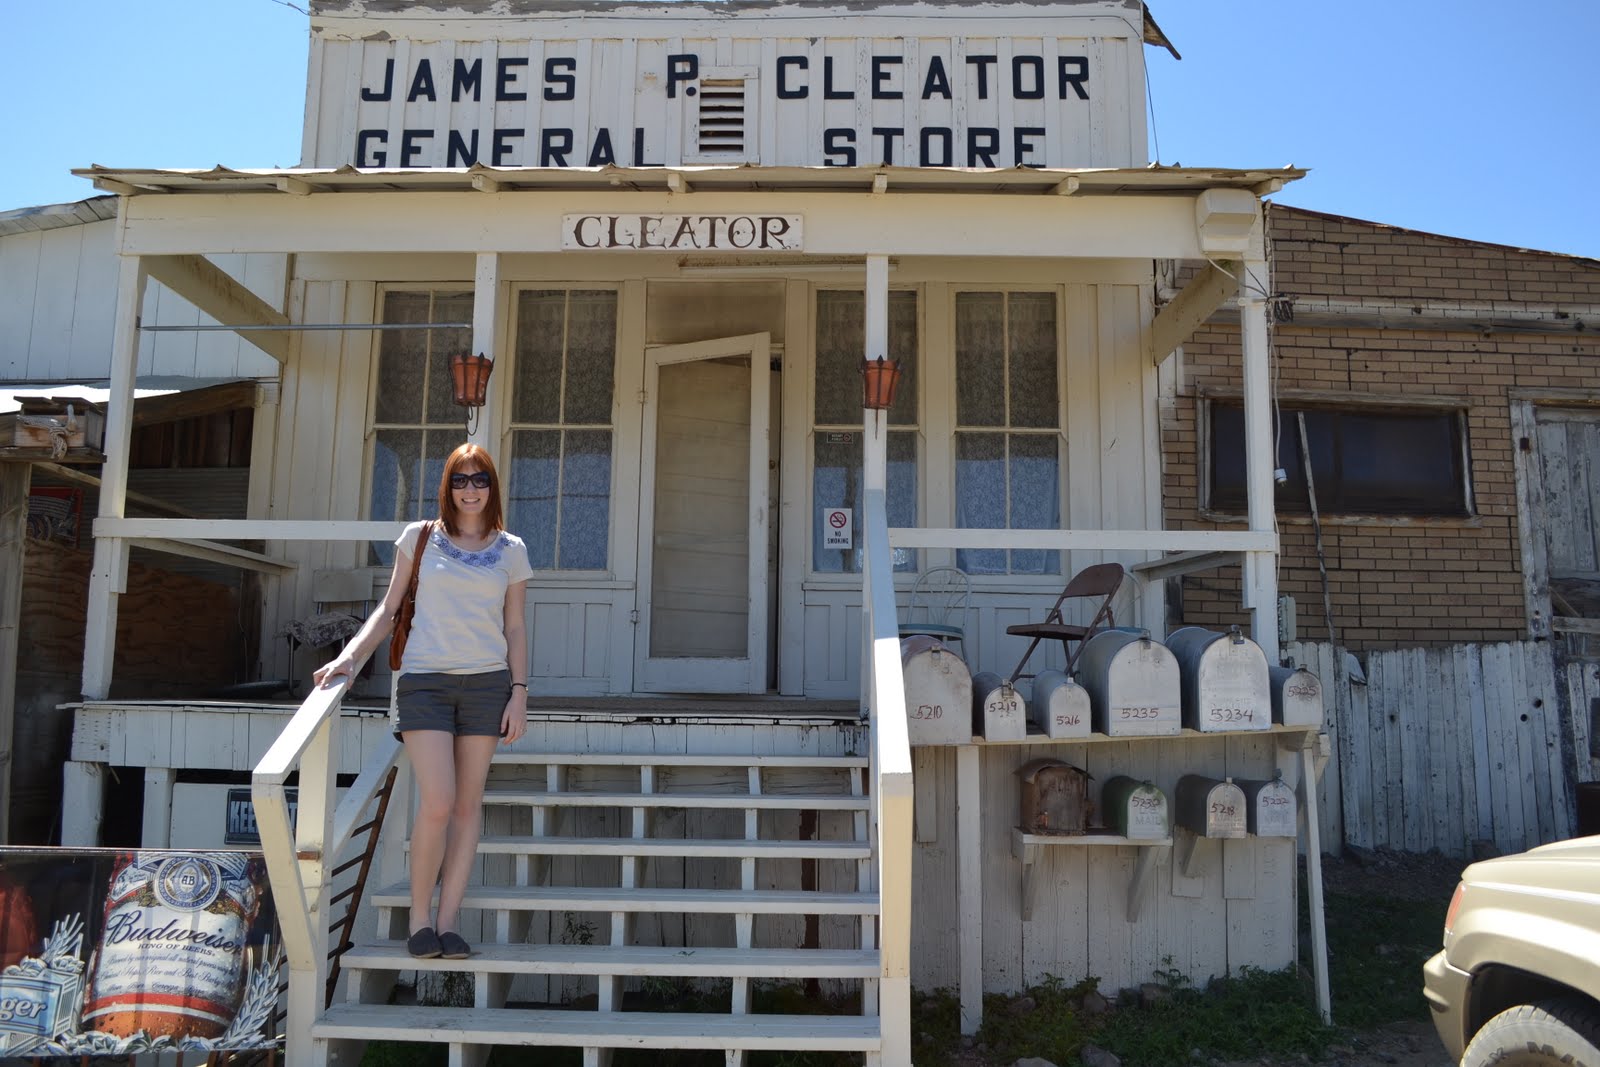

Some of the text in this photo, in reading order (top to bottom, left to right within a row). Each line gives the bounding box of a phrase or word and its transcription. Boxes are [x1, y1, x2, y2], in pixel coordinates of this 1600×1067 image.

[361, 54, 1090, 102] JAMES P. CLEATOR
[356, 127, 1046, 168] GENERAL STORE
[573, 216, 791, 249] CLEATOR
[911, 704, 942, 720] 5210
[989, 701, 1017, 712] 5219
[1121, 708, 1159, 719] 5235
[1056, 715, 1081, 726] 5216
[1210, 709, 1253, 722] 5234
[107, 910, 243, 956] Budweiser
